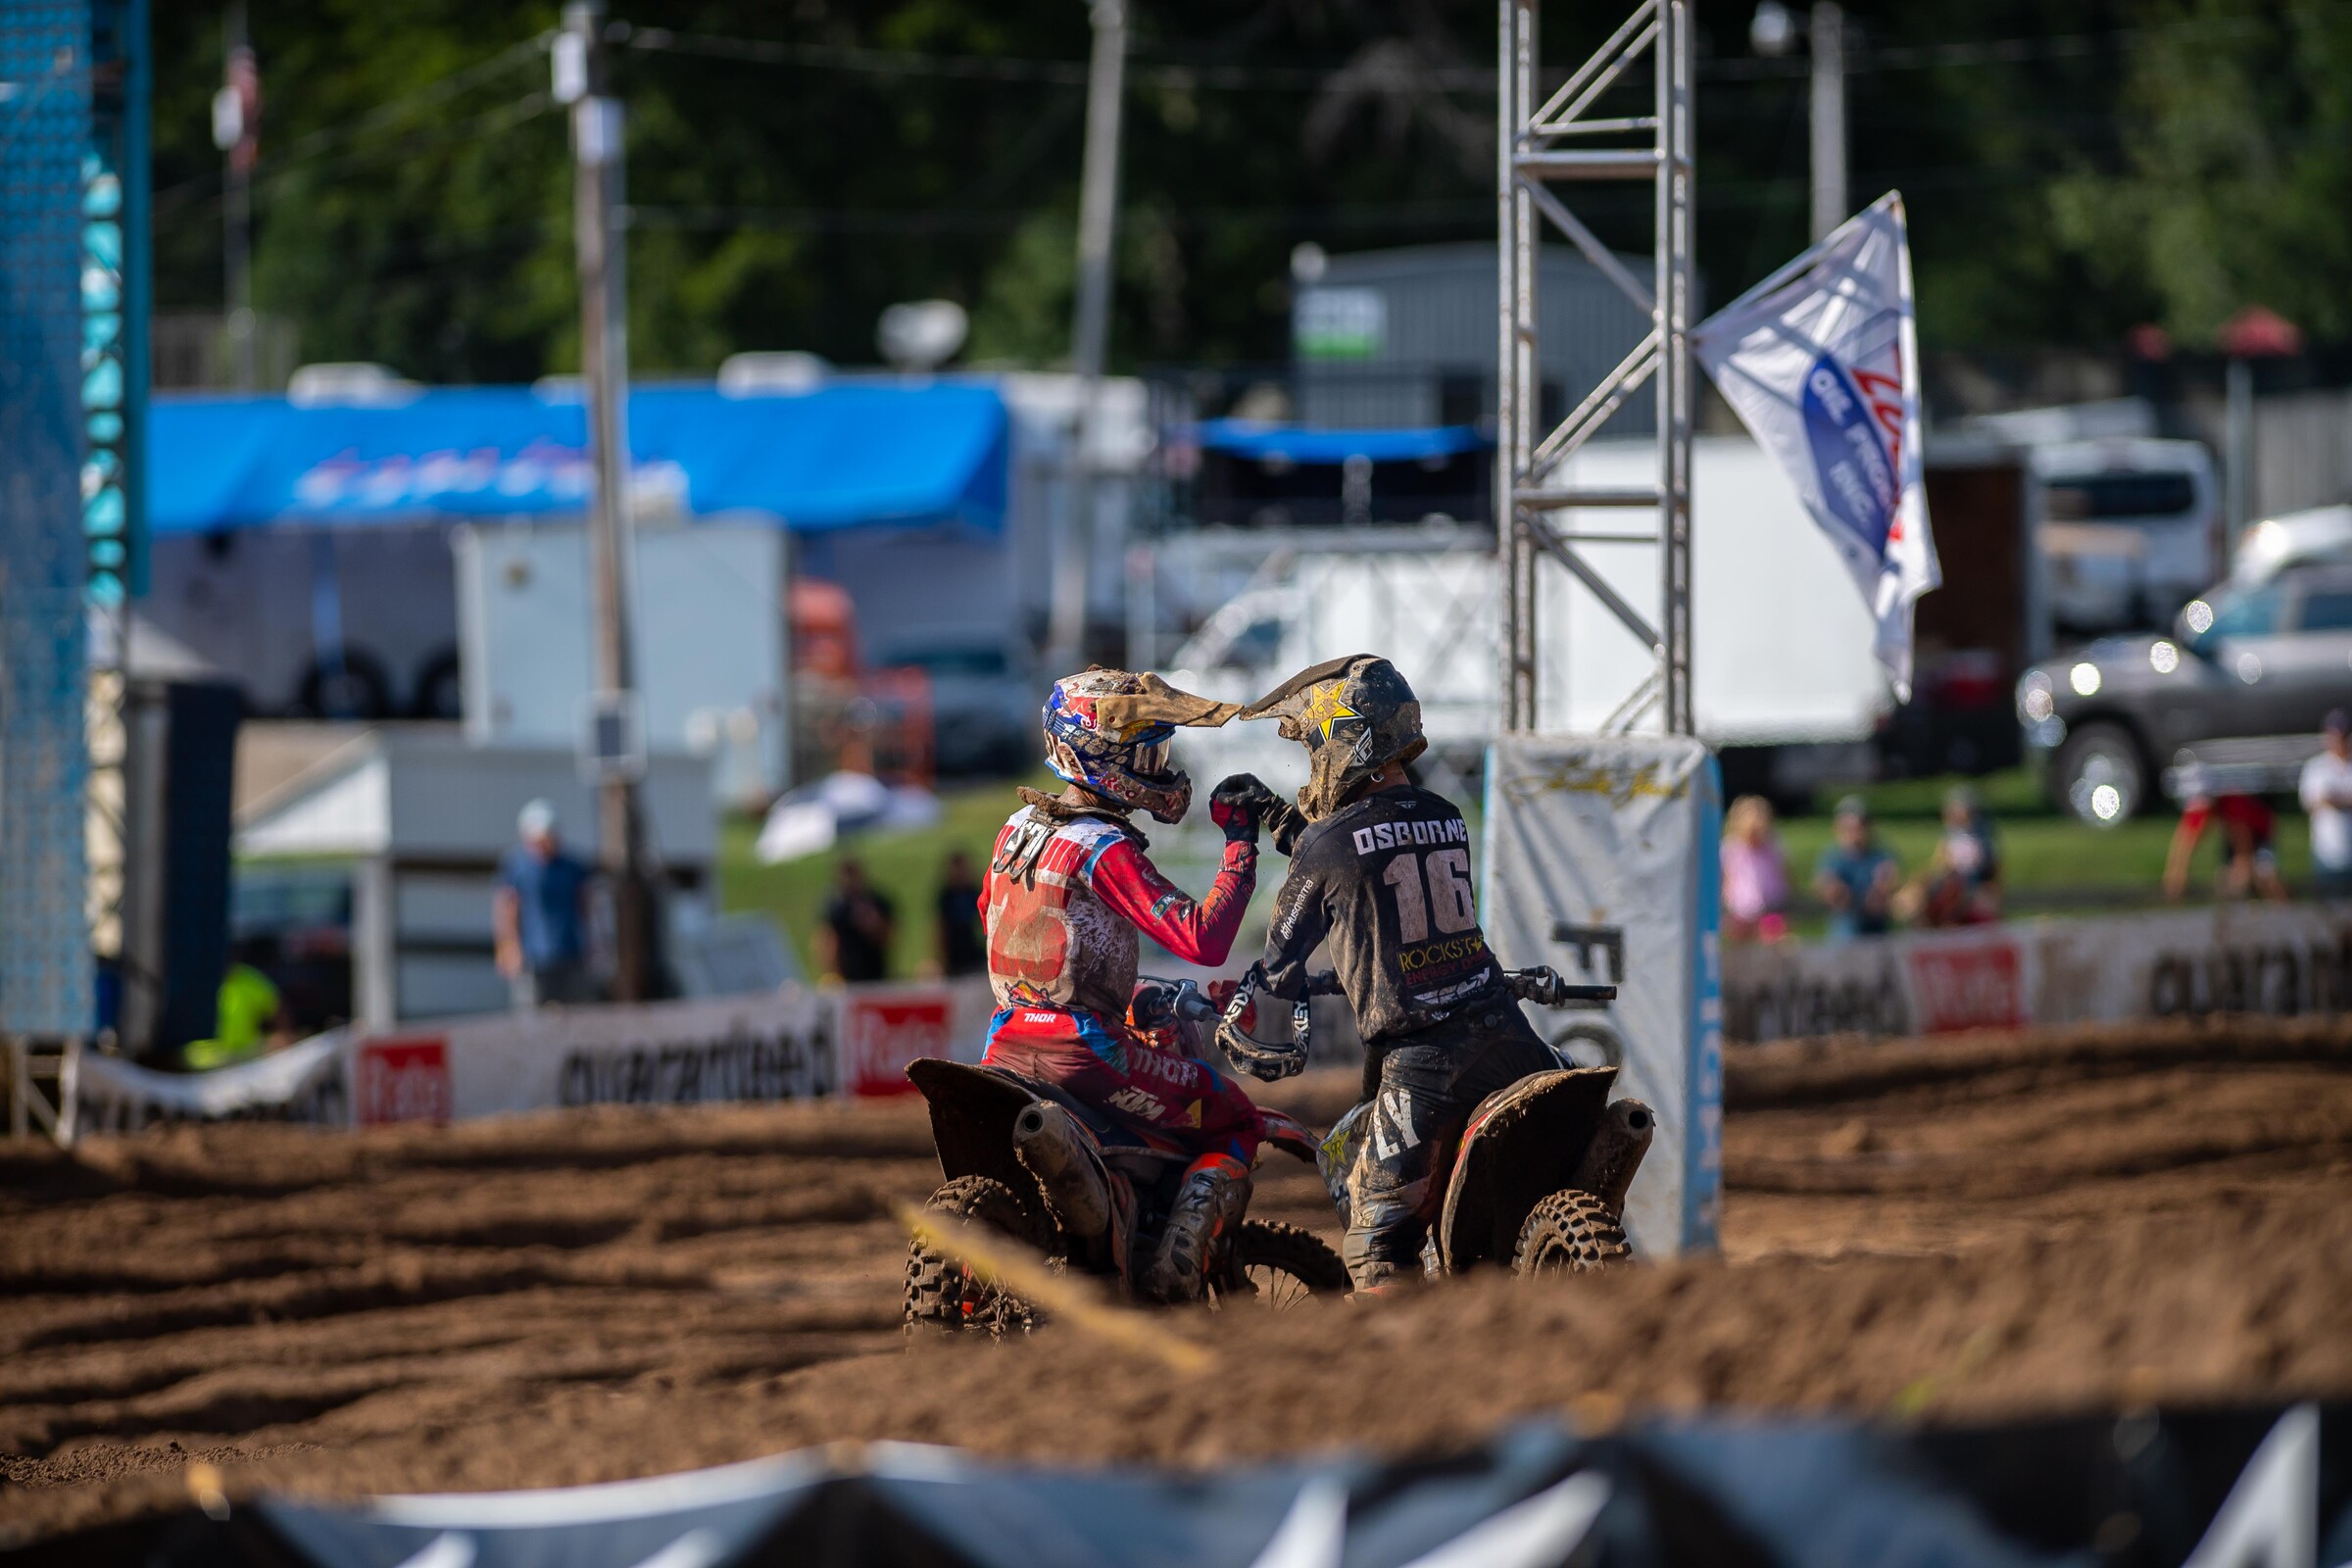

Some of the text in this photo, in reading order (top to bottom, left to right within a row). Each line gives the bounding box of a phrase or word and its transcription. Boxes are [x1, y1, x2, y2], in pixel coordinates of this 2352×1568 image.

[1352, 818, 1467, 856] OSBORNE
[1286, 879, 1313, 930] Husqvarna
[1383, 848, 1477, 944] 16
[991, 872, 1073, 982] 25
[1222, 970, 1257, 1024] OAKLEY
[1405, 962, 1457, 986] ENERGY
[1023, 1012, 1057, 1024] THOR
[1294, 1001, 1311, 1054] OAKLEY
[1131, 1048, 1199, 1089] THOR
[1107, 1085, 1167, 1121] KTM
[1372, 1090, 1421, 1161] LY
